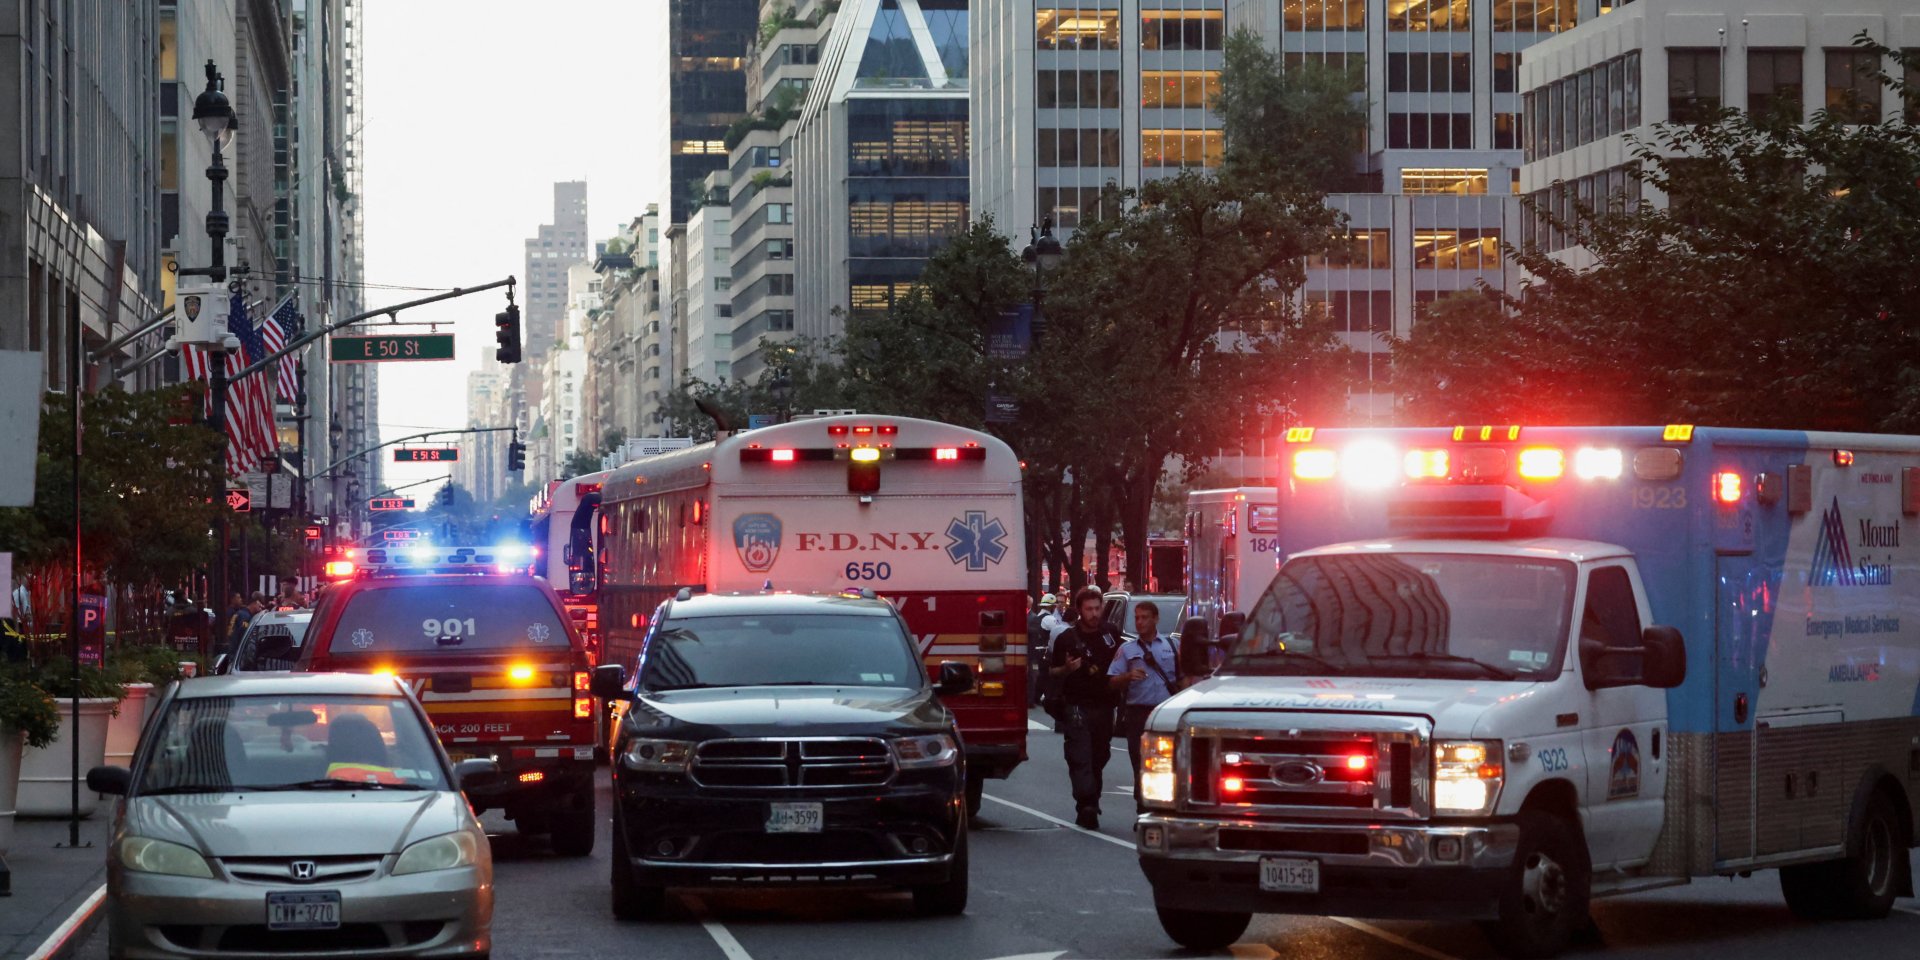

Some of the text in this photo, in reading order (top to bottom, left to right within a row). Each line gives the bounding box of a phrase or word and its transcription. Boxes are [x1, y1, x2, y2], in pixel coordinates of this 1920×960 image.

[364, 339, 420, 357] E 50 St
[412, 450, 440, 460] E 51 St
[1631, 486, 1688, 509] 1923
[795, 532, 940, 551] F.D.N.Y.
[1859, 518, 1900, 548] Mount
[845, 561, 892, 581] 650
[1859, 554, 1892, 586] Sinai
[84, 609, 97, 628] P
[422, 618, 476, 637] 901
[1806, 614, 1900, 639] Emergency Medical Services
[1828, 663, 1880, 682] AMBULANCE
[433, 722, 512, 734] ACK 200 FEET
[1538, 747, 1569, 773] 1923
